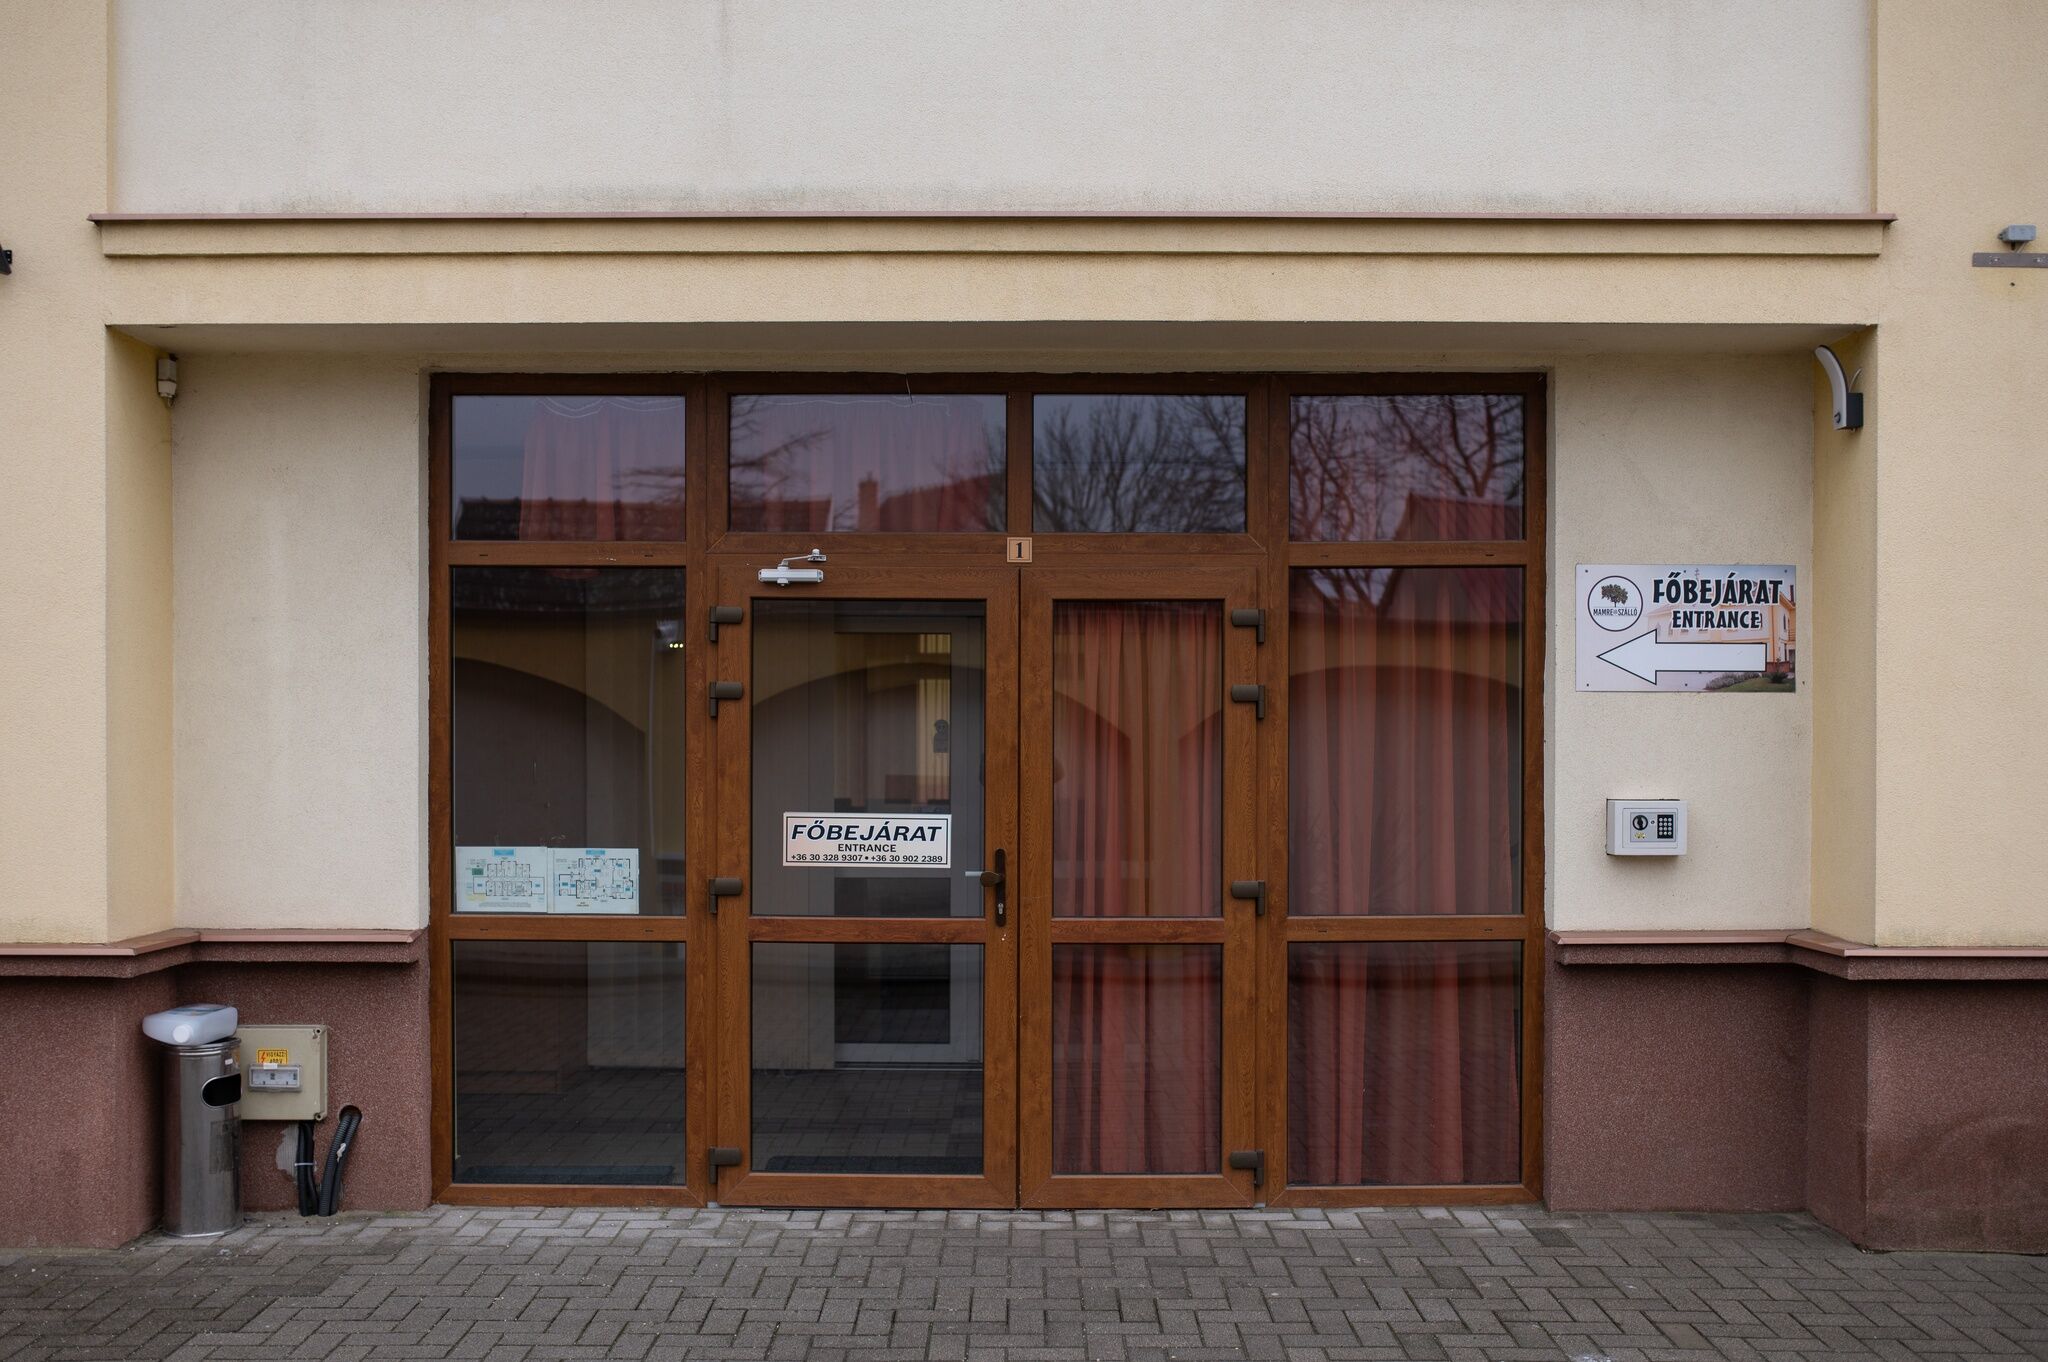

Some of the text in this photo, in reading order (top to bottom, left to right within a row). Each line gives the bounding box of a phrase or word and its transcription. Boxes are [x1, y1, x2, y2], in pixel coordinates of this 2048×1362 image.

[1016, 542, 1024, 558] 1
[1653, 572, 1783, 607] FŐBEJÁRAT
[1593, 608, 1614, 616] MAMRE
[1672, 610, 1761, 629] ENTRANCE
[791, 820, 943, 842] FŐBEJÁRAT
[838, 843, 897, 853] ENTRANCE
[902, 855, 919, 863] 902
[921, 855, 943, 863] 2389
